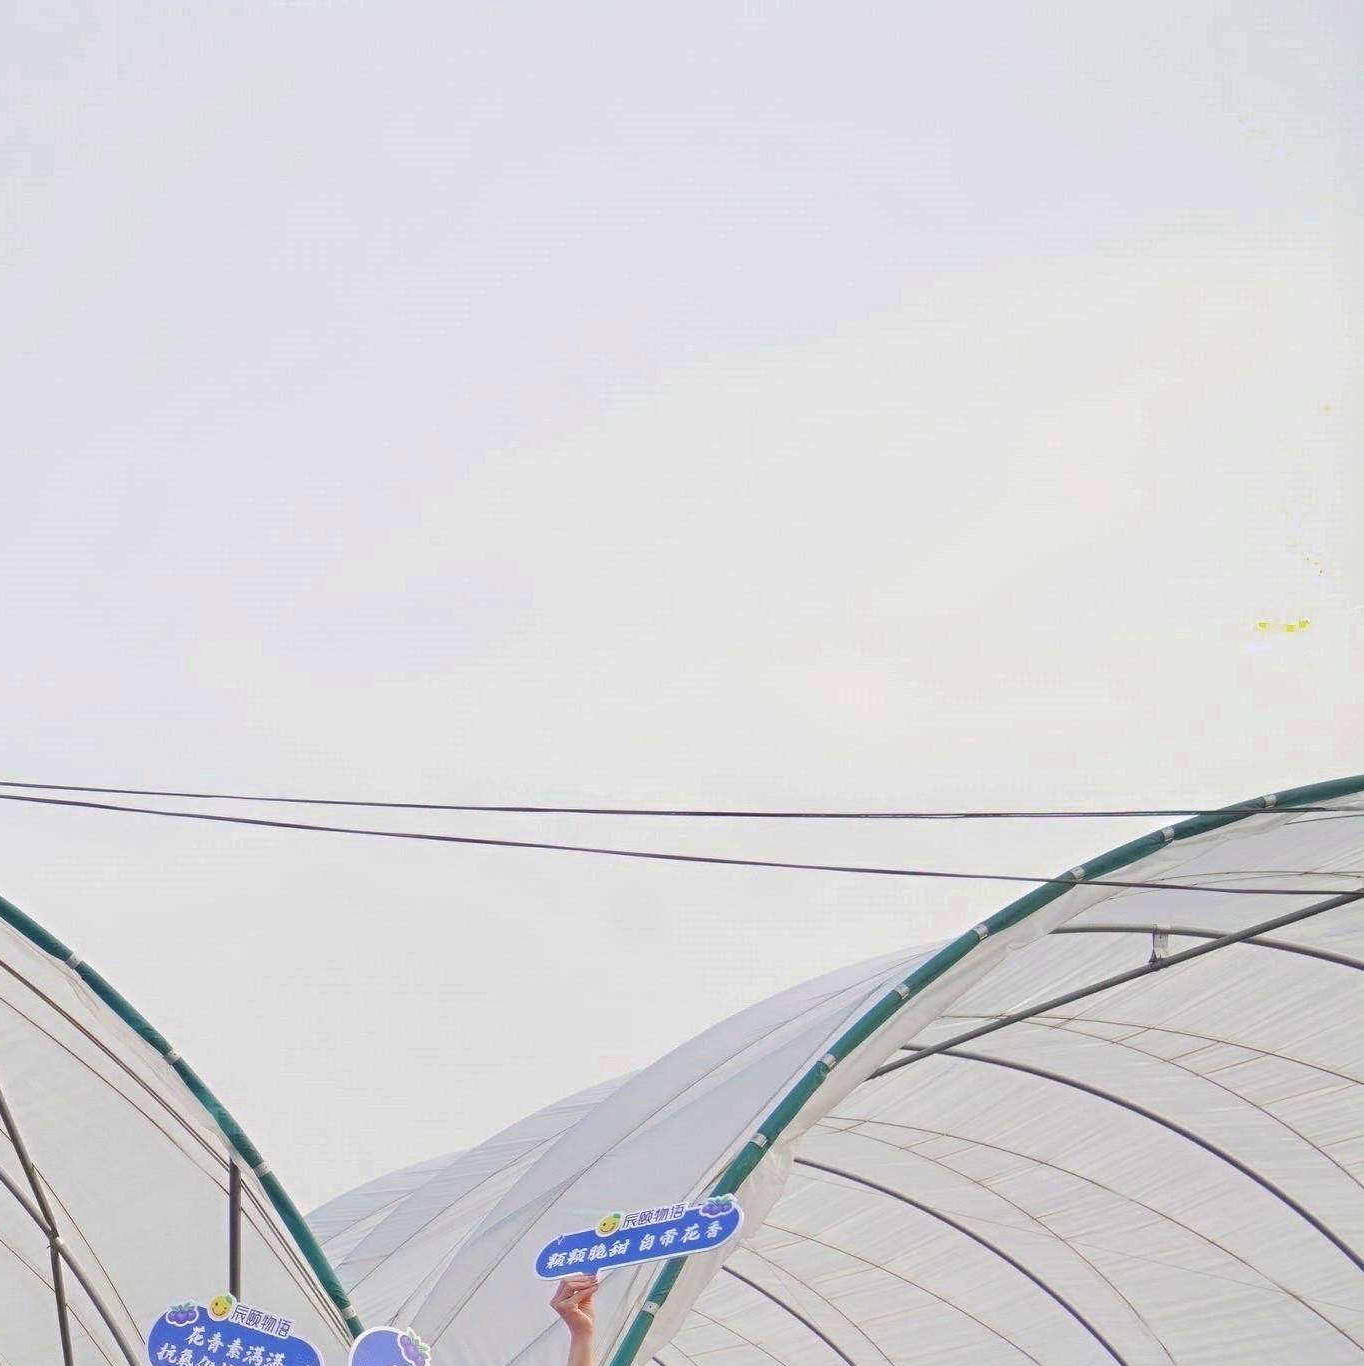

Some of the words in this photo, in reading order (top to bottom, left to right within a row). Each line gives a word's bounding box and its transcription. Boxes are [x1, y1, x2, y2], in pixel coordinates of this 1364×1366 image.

[622, 1203, 686, 1228] 辰颐物语
[545, 1238, 631, 1270] 颗颗脆甜
[638, 1220, 723, 1252] 自带花香
[230, 1304, 292, 1338] 辰颐物语
